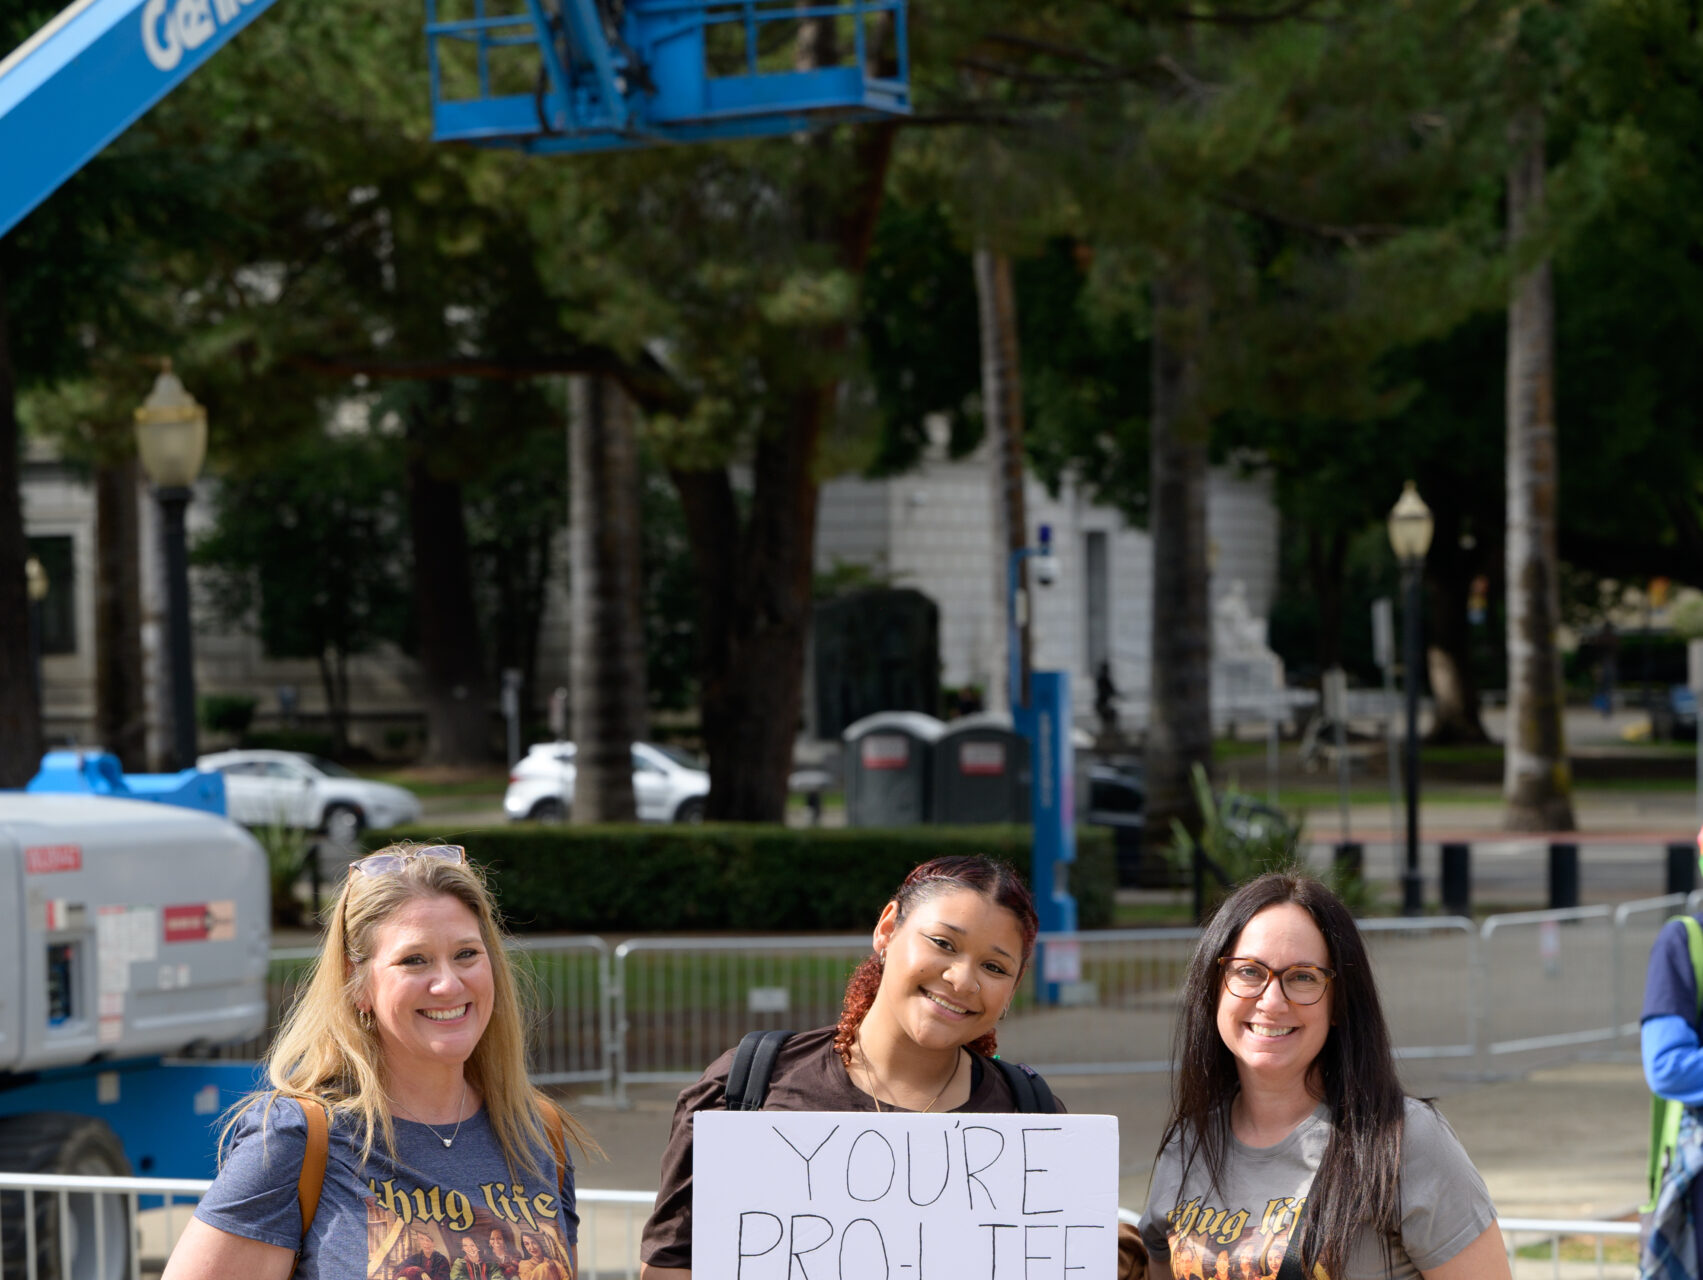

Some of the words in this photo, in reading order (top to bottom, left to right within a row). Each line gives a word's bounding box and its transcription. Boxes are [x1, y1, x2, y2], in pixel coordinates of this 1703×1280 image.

[772, 1119, 1063, 1214] YOU'RE
[480, 1181, 560, 1232] life
[1167, 1195, 1251, 1245] thug
[1259, 1196, 1308, 1242] lif
